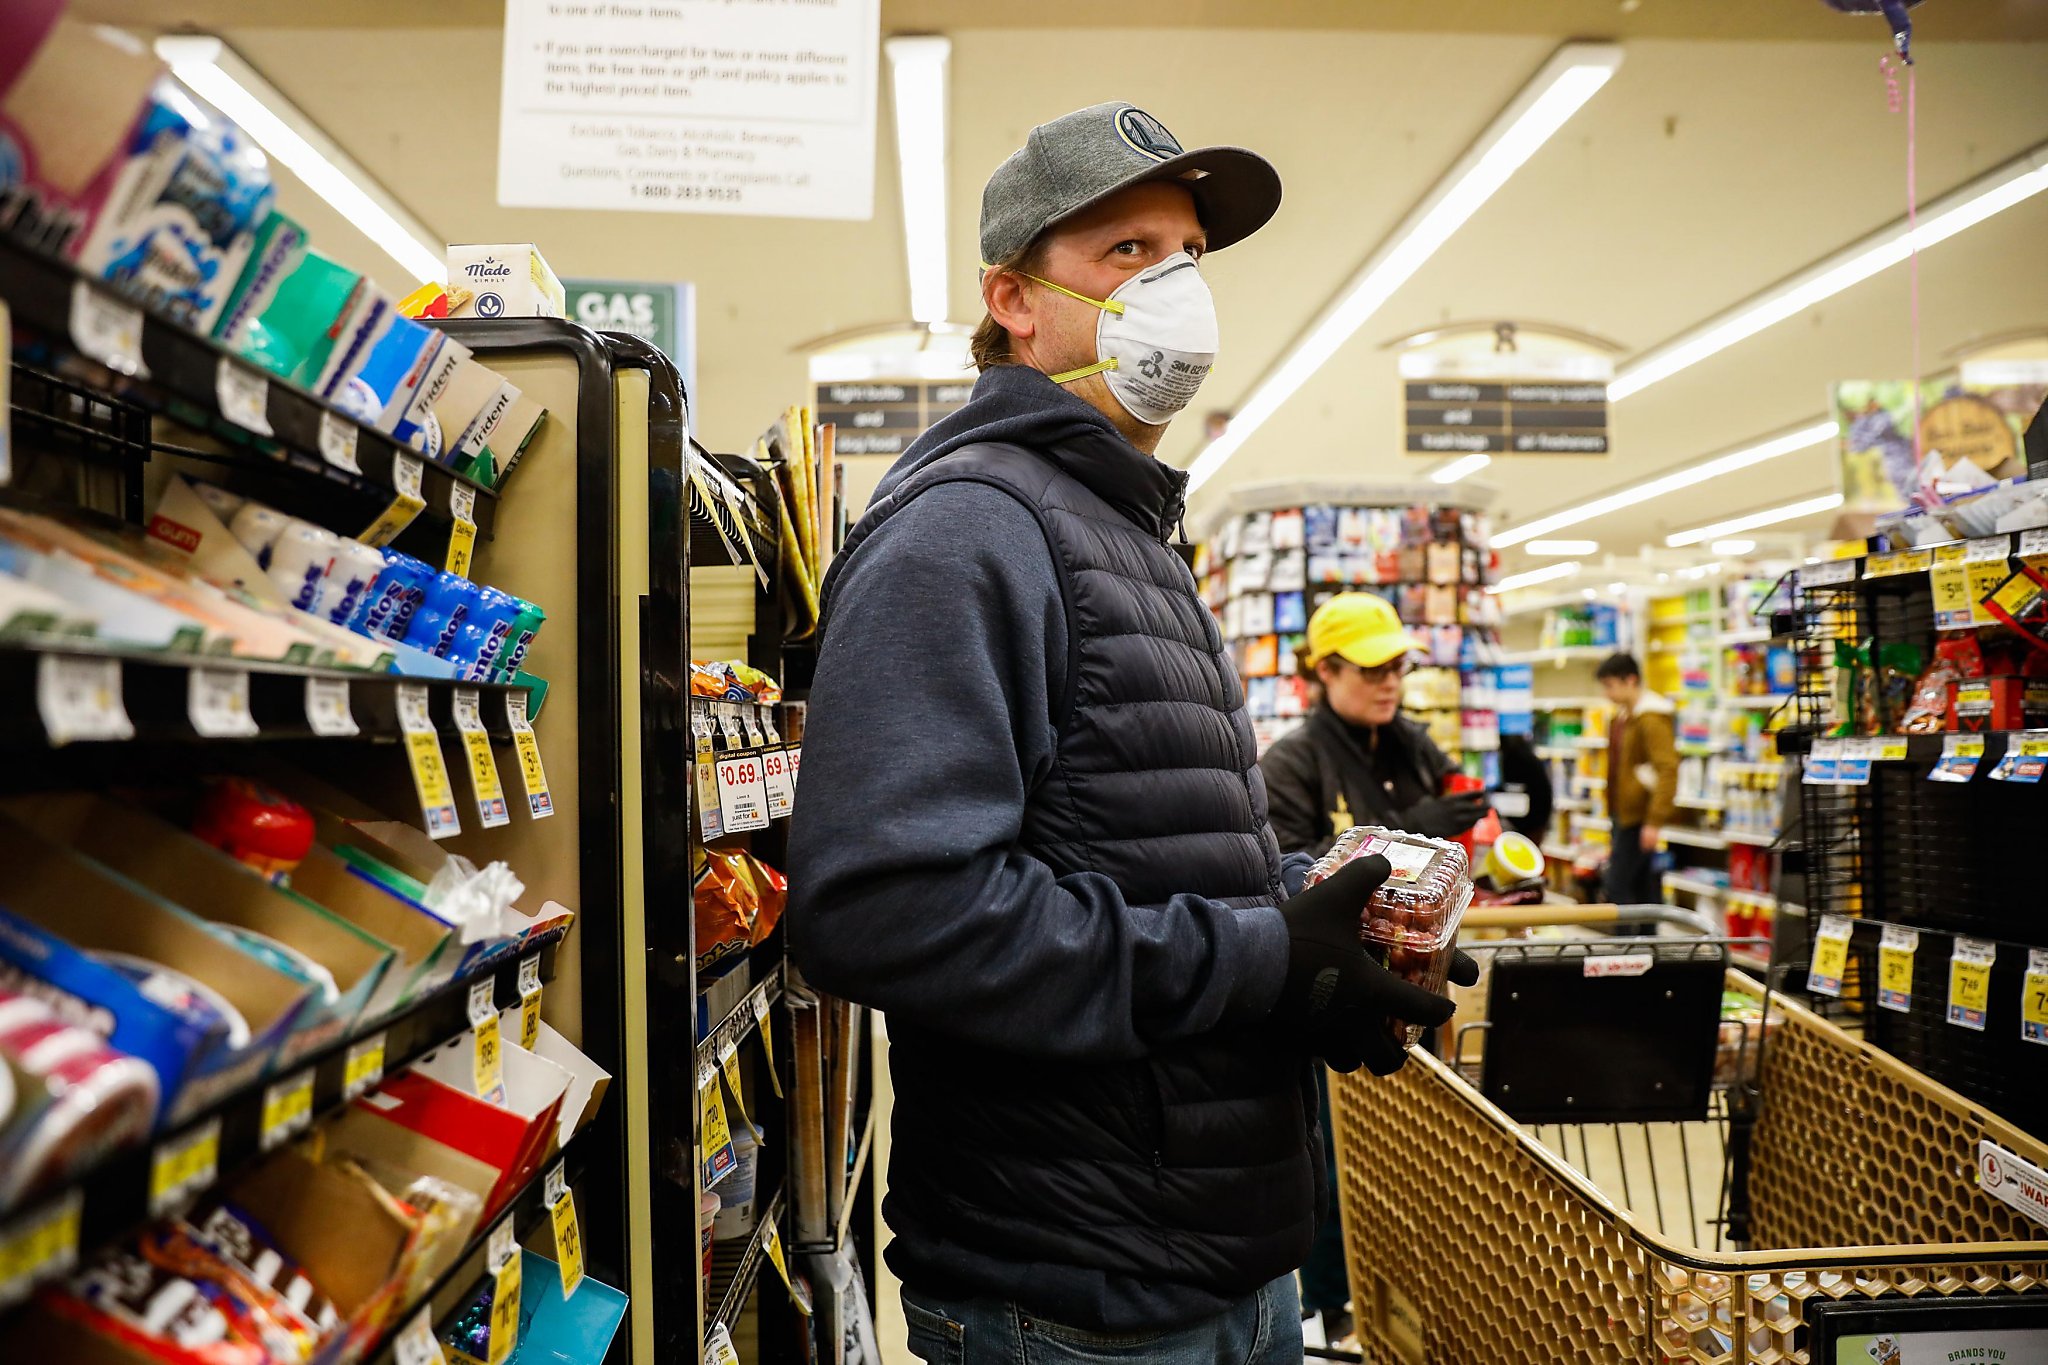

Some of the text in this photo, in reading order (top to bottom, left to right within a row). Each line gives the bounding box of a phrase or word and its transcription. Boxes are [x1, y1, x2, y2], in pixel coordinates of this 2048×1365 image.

[566, 6, 587, 16] one
[594, 4, 606, 16] of
[611, 4, 643, 17] those
[558, 45, 579, 58] you
[586, 46, 602, 57] are
[610, 46, 686, 60] overcharged
[692, 47, 708, 58] for
[713, 49, 737, 60] two
[759, 52, 789, 63] more
[795, 51, 848, 65] different
[587, 63, 606, 75] the
[613, 63, 634, 76] free
[640, 65, 666, 76] item
[690, 66, 708, 80] gift
[715, 67, 742, 80] card
[745, 69, 781, 85] policy
[787, 71, 830, 86] applies
[545, 81, 564, 94] the
[570, 82, 617, 97] highest
[620, 83, 657, 99] priced
[465, 263, 512, 276] Made
[576, 291, 654, 324] GAS
[1171, 360, 1191, 373] 3M
[417, 355, 458, 415] Trident
[471, 393, 511, 447] Trident
[719, 750, 757, 760] digital coupon
[720, 763, 755, 786] $0.69
[731, 814, 743, 822] just
[743, 812, 751, 820] for
[1947, 1347, 2006, 1362] BRANDS YOU
